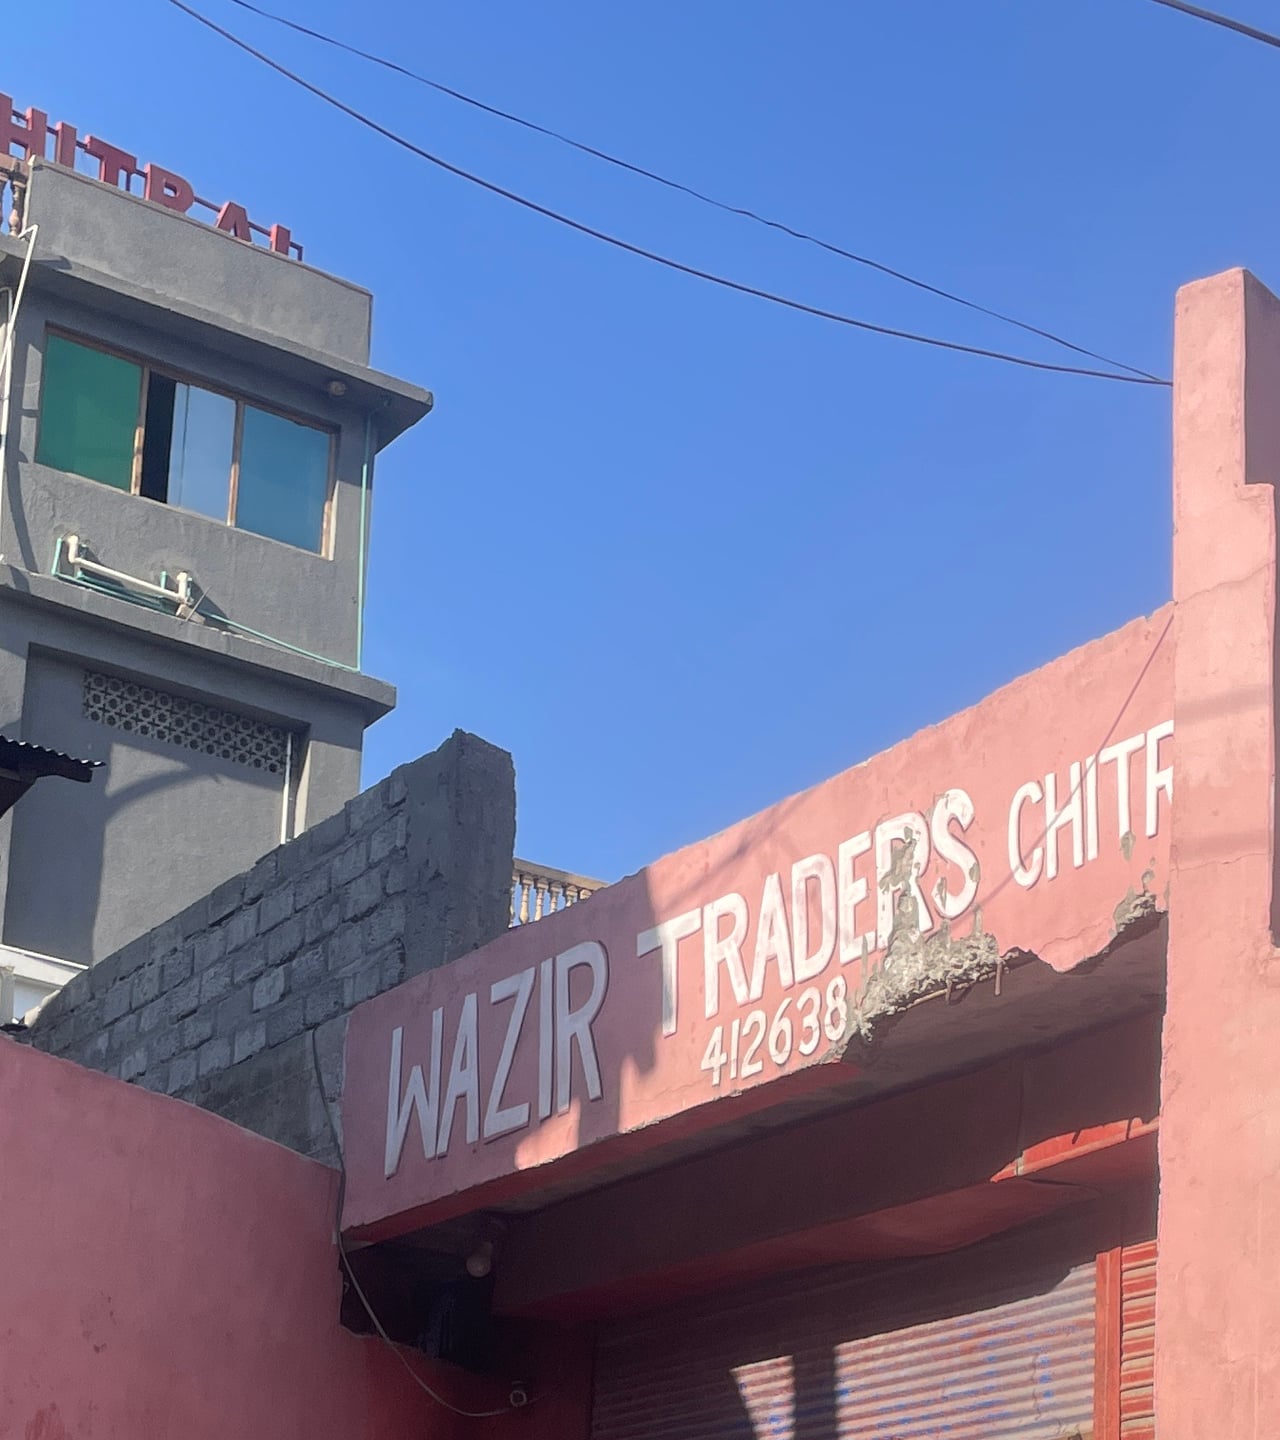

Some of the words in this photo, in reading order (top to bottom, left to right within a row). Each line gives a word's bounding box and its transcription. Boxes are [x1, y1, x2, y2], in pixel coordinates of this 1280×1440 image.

[384, 940, 610, 1180] WAZIR
[637, 787, 982, 1037] TRADERS
[699, 975, 849, 1087] 412638
